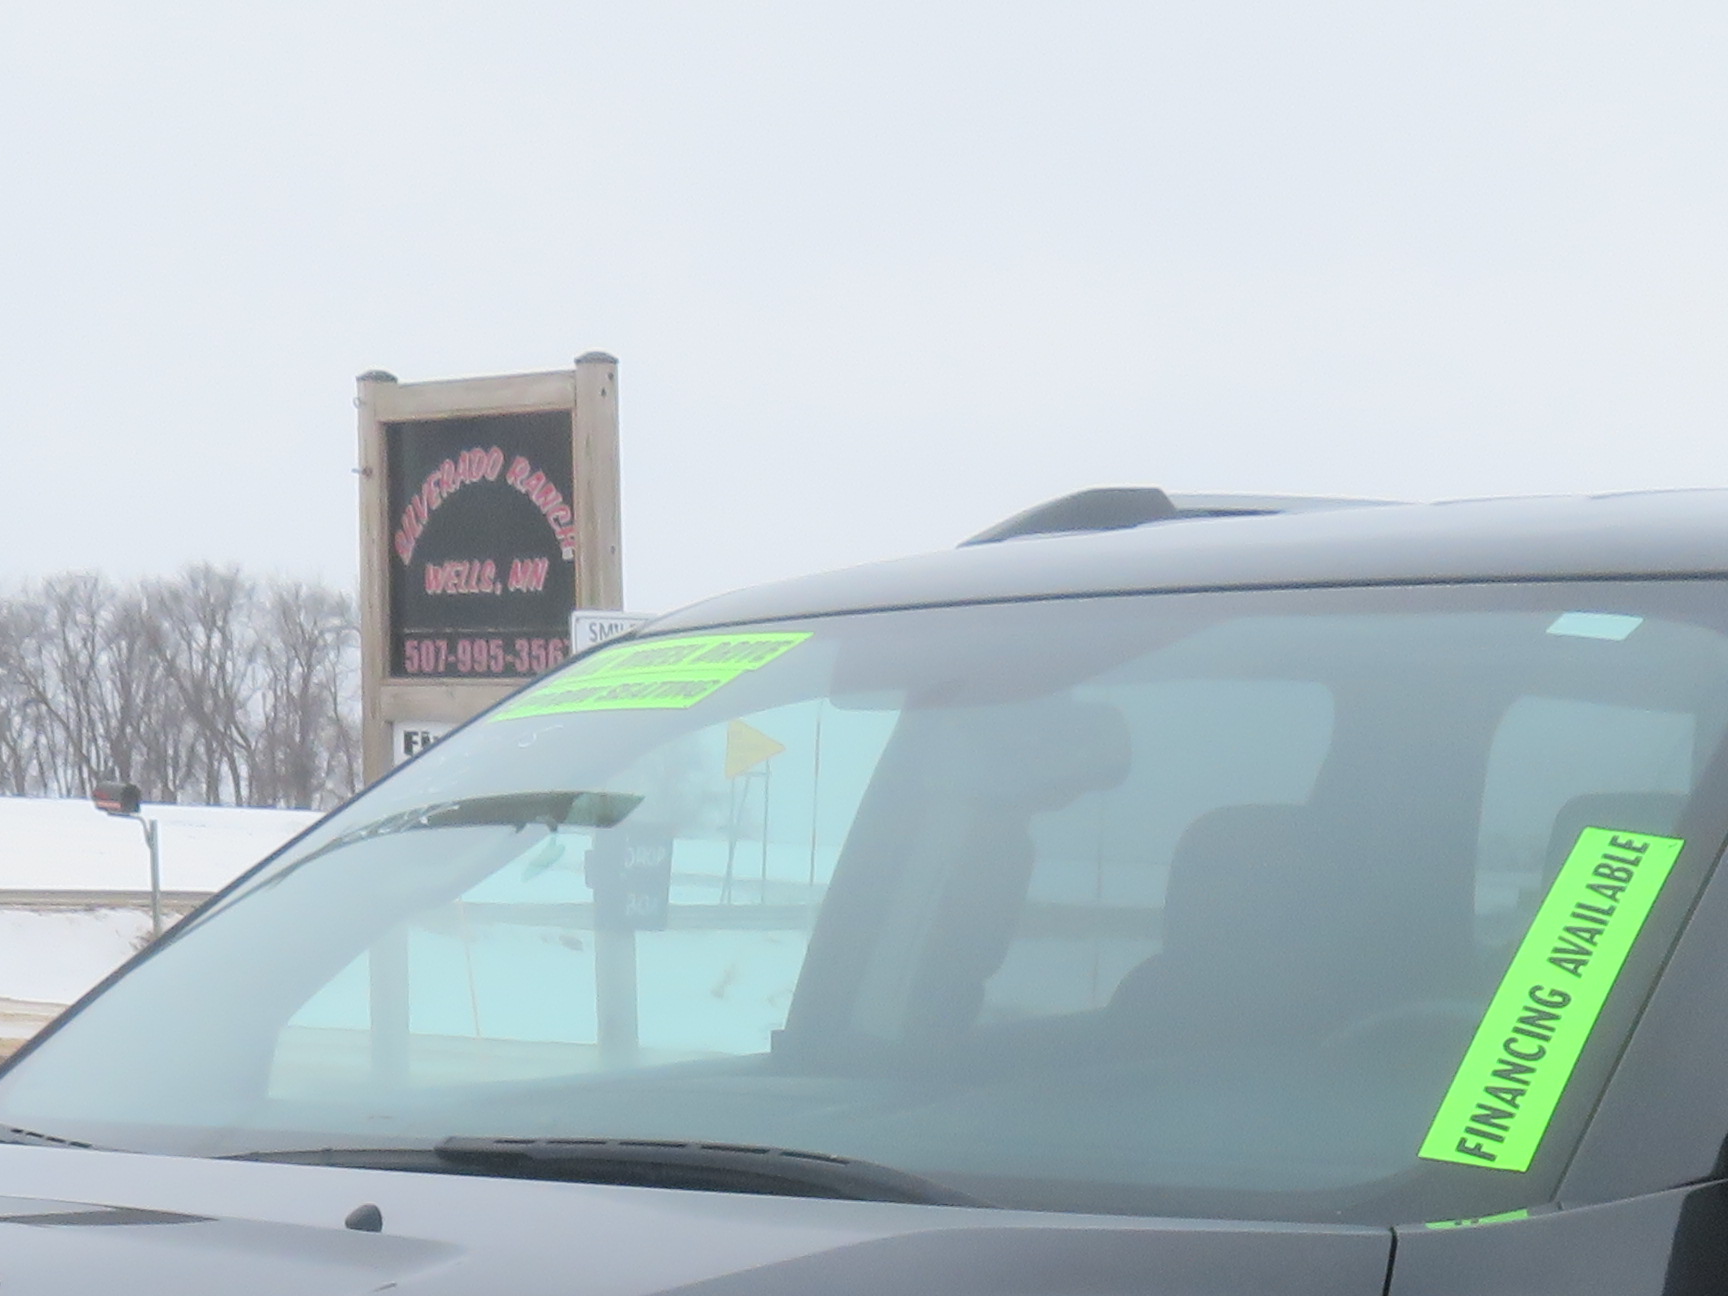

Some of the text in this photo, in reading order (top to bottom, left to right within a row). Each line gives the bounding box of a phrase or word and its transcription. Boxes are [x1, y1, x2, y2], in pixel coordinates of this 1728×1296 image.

[394, 446, 504, 566] SILVERADO
[425, 557, 550, 595] WELLS, MN
[1455, 834, 1651, 1163] FINANCING AVAILABLE
